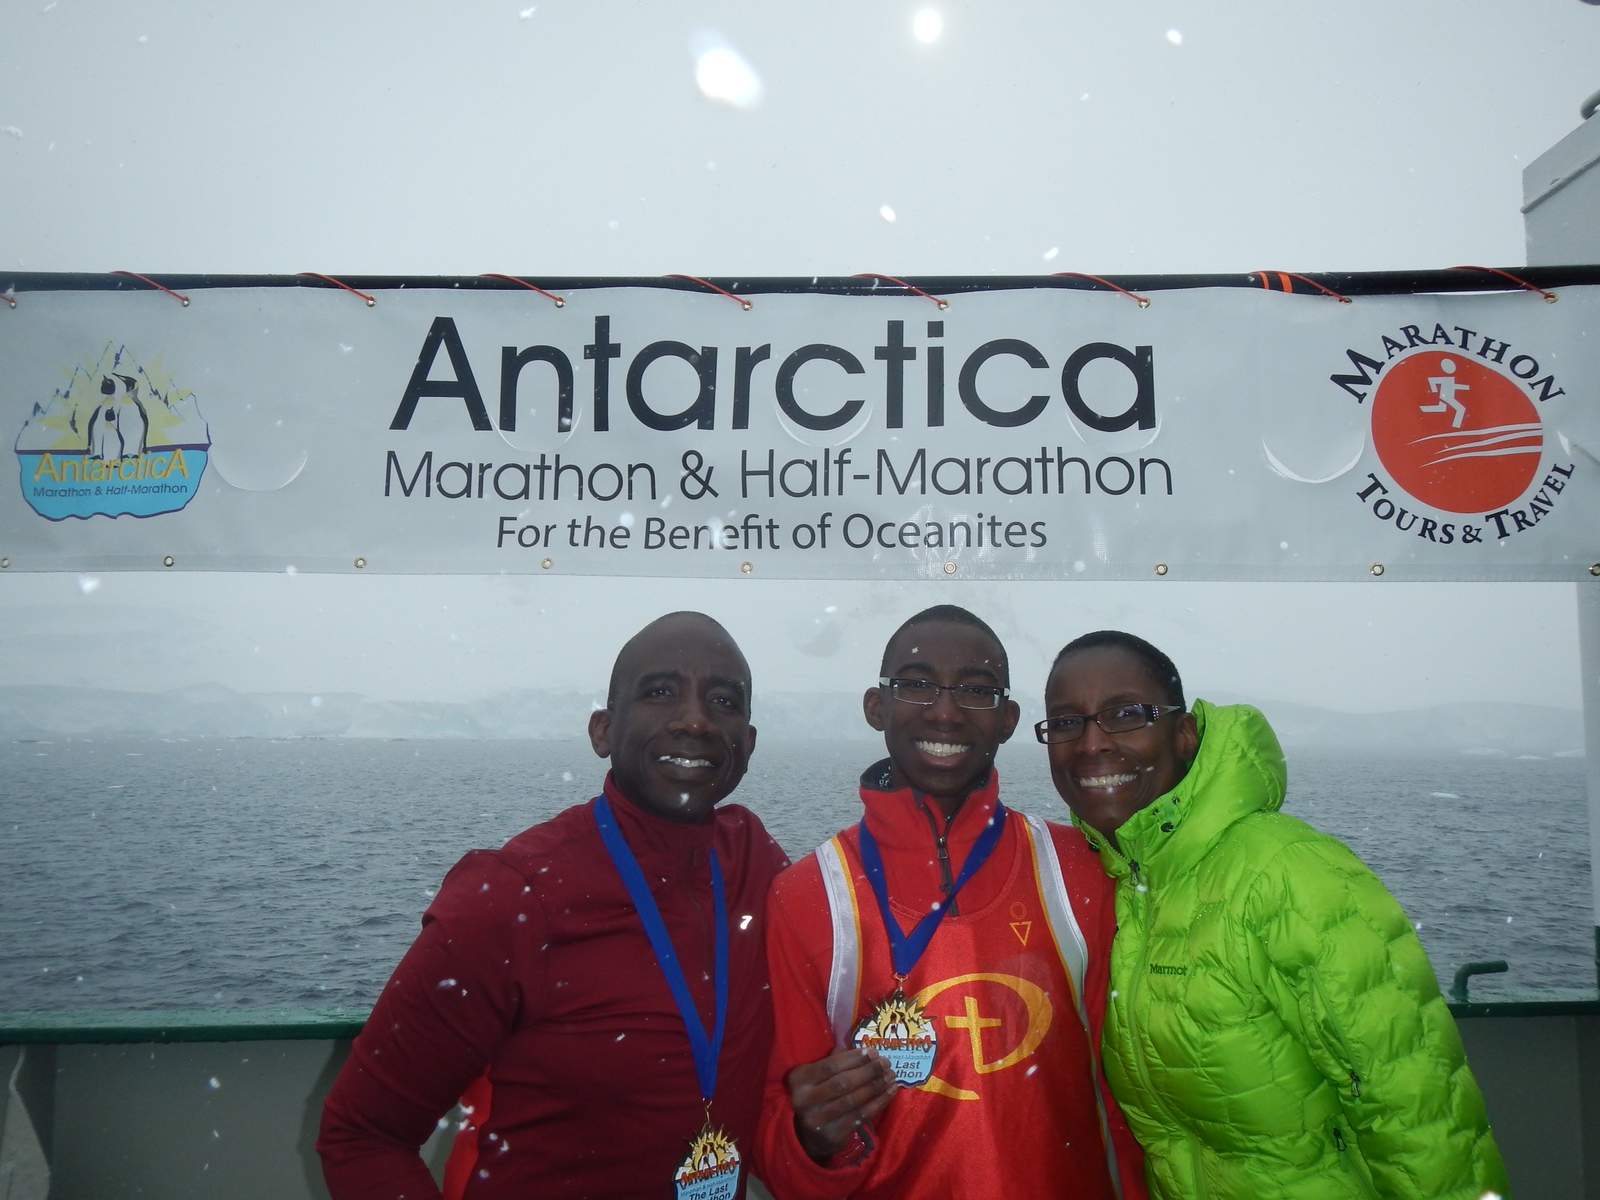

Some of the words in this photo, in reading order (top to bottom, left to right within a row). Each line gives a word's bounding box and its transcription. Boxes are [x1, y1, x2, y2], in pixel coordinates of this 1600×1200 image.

[389, 315, 1156, 433] Antarctica
[385, 450, 657, 501] Marathon
[679, 449, 720, 500] &
[741, 446, 1173, 499] Half-Marathon
[33, 486, 92, 498] Marathon
[94, 486, 103, 496] &
[106, 483, 188, 496] Half-Marathon
[497, 516, 557, 548] For
[567, 515, 631, 549] the
[643, 513, 782, 550] Benefit
[792, 511, 833, 550] of
[842, 512, 1047, 549] Oceanites
[1462, 524, 1483, 544] &
[895, 1060, 920, 1069] Last
